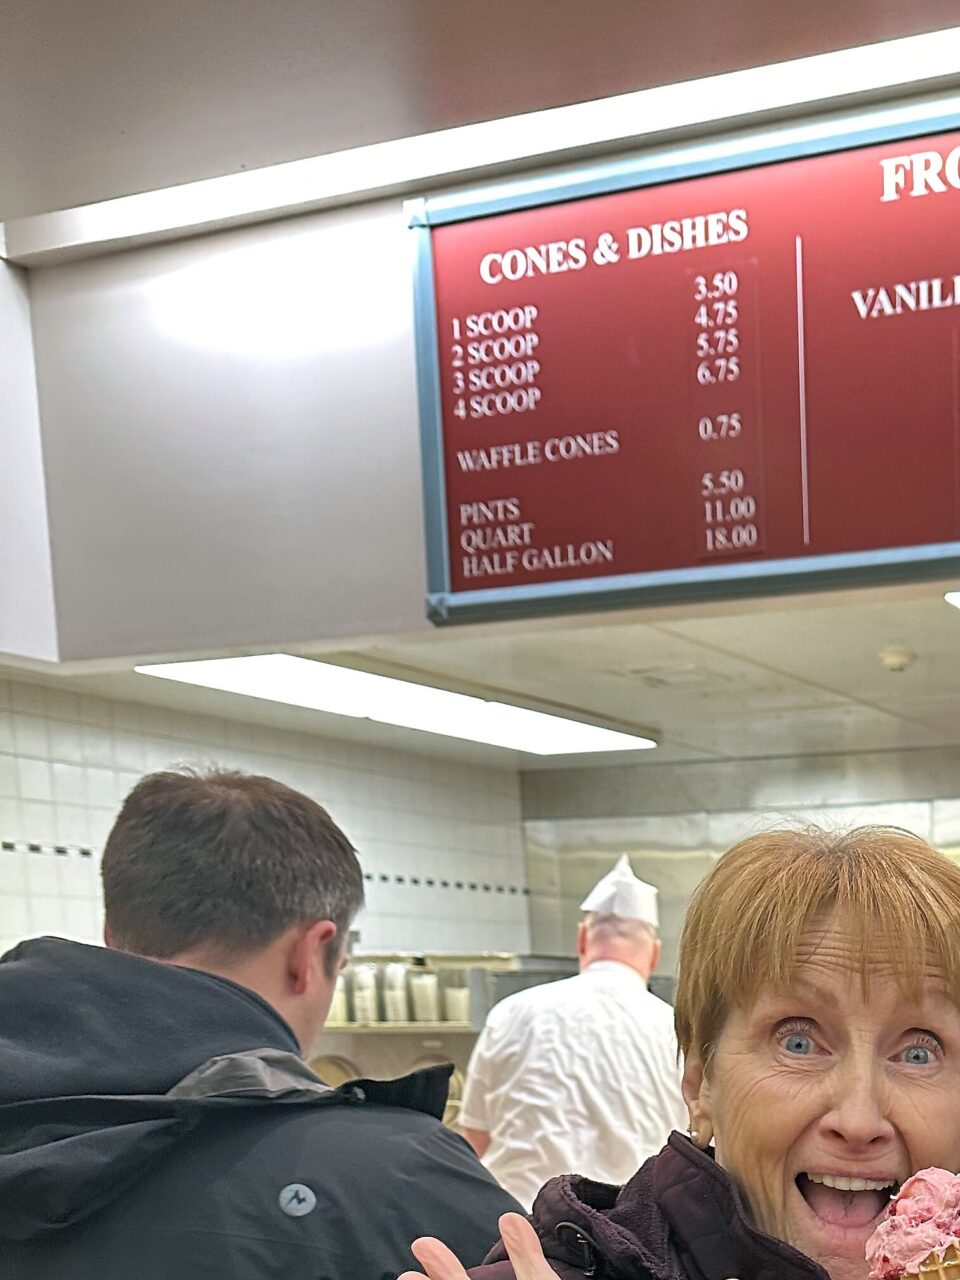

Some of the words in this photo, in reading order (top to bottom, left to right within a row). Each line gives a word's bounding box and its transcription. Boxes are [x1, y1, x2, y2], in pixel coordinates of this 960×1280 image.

[480, 239, 587, 284] CONES
[593, 233, 620, 265] &
[627, 209, 748, 260] DISHES
[694, 271, 738, 301] 3.50
[453, 318, 461, 340] 1
[466, 305, 537, 338] SCOOP
[695, 299, 738, 328] 4.75
[452, 345, 464, 367] 2
[467, 333, 538, 364] SCOOP
[697, 328, 738, 357] 5.75
[454, 372, 465, 394] 3
[469, 360, 540, 391] SCOOP
[697, 356, 739, 385] 6.75
[454, 399, 467, 420] 4
[470, 387, 541, 418] SCOOP
[699, 413, 741, 440] 0.75
[457, 441, 541, 472] WAFFLE
[545, 430, 619, 461] CONES
[702, 470, 744, 496] 5.50
[460, 498, 520, 525] PINTS
[705, 496, 755, 523] 11.00
[461, 523, 534, 554] QUART
[706, 524, 757, 551] 18.00
[463, 551, 518, 576] HALF
[522, 540, 613, 569] GALLON
